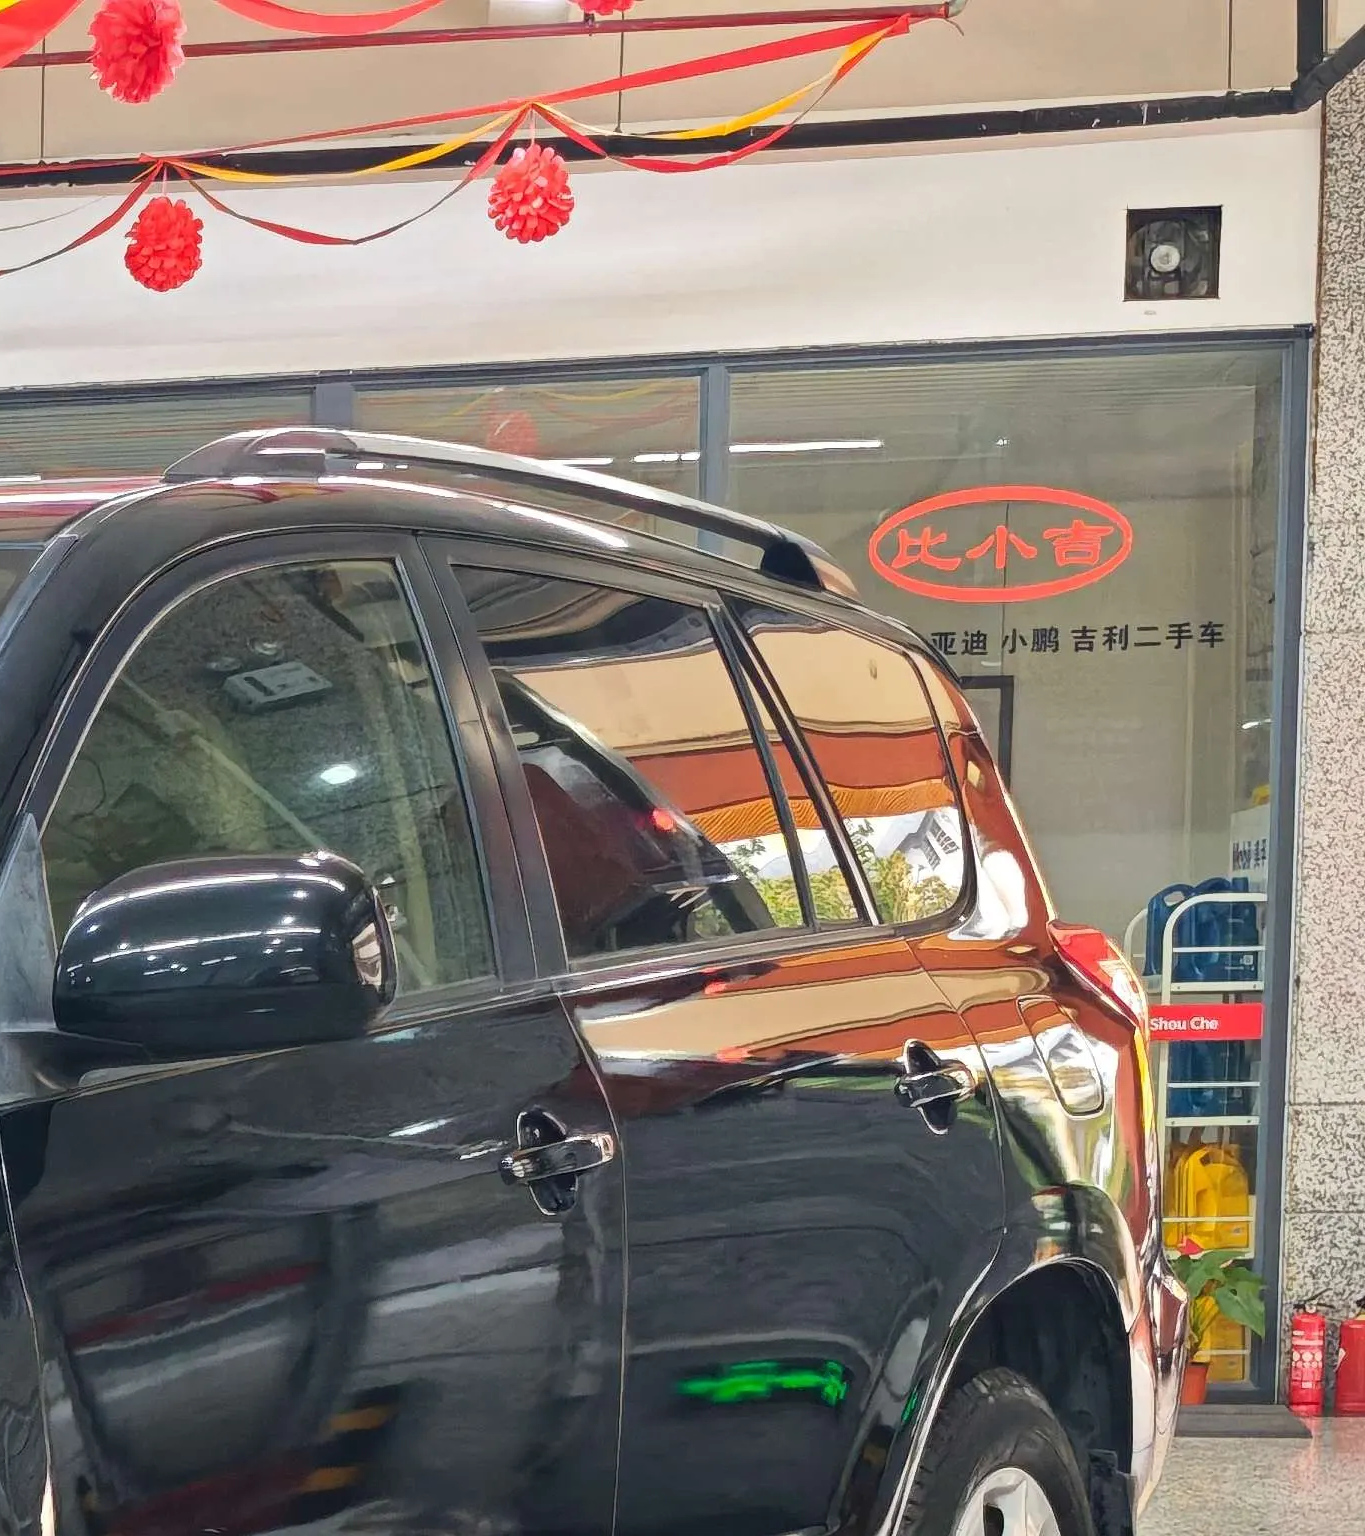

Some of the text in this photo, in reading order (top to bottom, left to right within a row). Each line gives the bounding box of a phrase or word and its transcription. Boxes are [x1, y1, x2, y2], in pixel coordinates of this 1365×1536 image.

[891, 519, 1115, 570] 比小吉
[930, 621, 1225, 656] 亚迪 小鹏 吉利二手车
[1150, 1017, 1187, 1031] Shou
